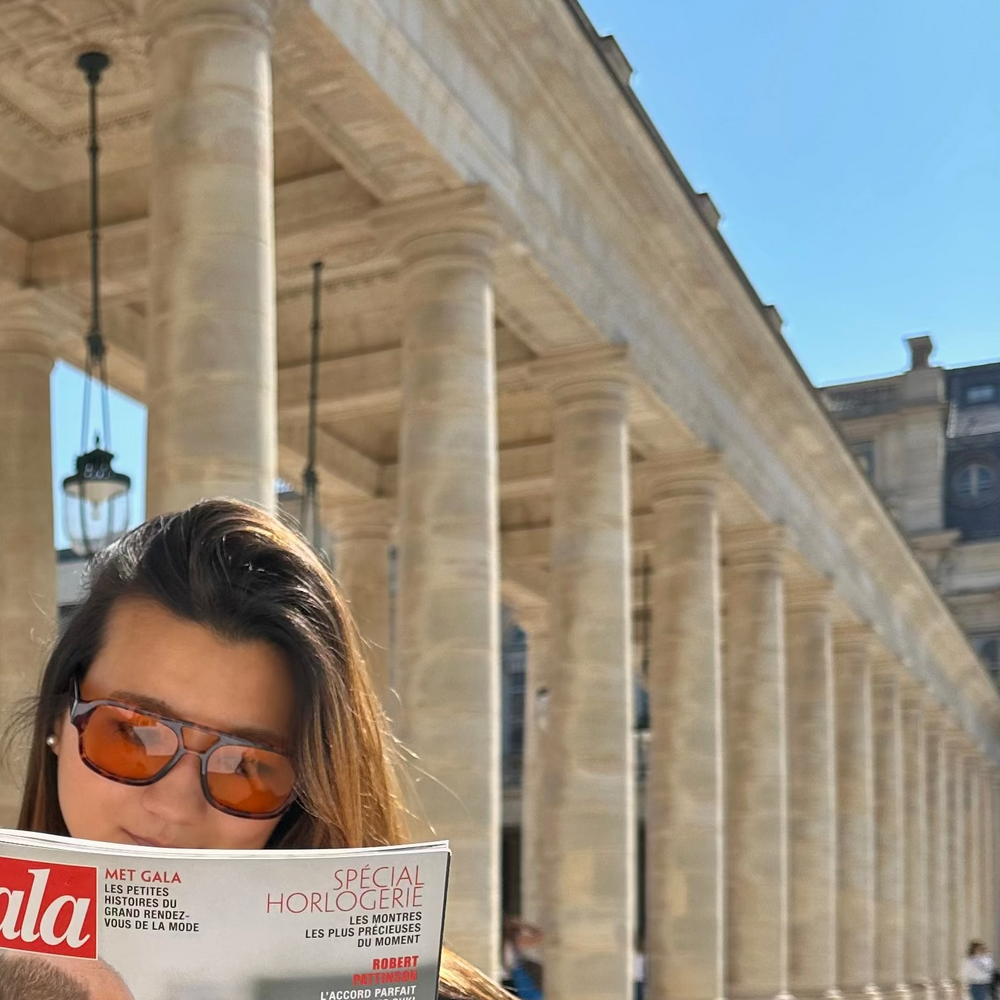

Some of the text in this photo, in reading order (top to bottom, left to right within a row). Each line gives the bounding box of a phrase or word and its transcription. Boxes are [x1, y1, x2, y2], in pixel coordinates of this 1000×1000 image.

[105, 868, 182, 883] MET GALA
[333, 863, 425, 891] SPÉCIAL
[105, 884, 169, 896] LES PETITES
[105, 895, 177, 908] HISTOIRES DU
[266, 886, 423, 914] HORLOGERIE
[105, 907, 190, 920] GRAND RENDEZ-
[350, 911, 422, 925] LES MONTRES
[104, 918, 199, 932] VOUS DE LA MODE
[305, 923, 421, 939] LES PLUS PRÉCIEUSES
[357, 934, 420, 948] DU MOMENT
[372, 955, 419, 970] ROBERT
[352, 969, 418, 986] PATTINSON
[320, 985, 417, 1000] L'ACCORD PARFAIT
